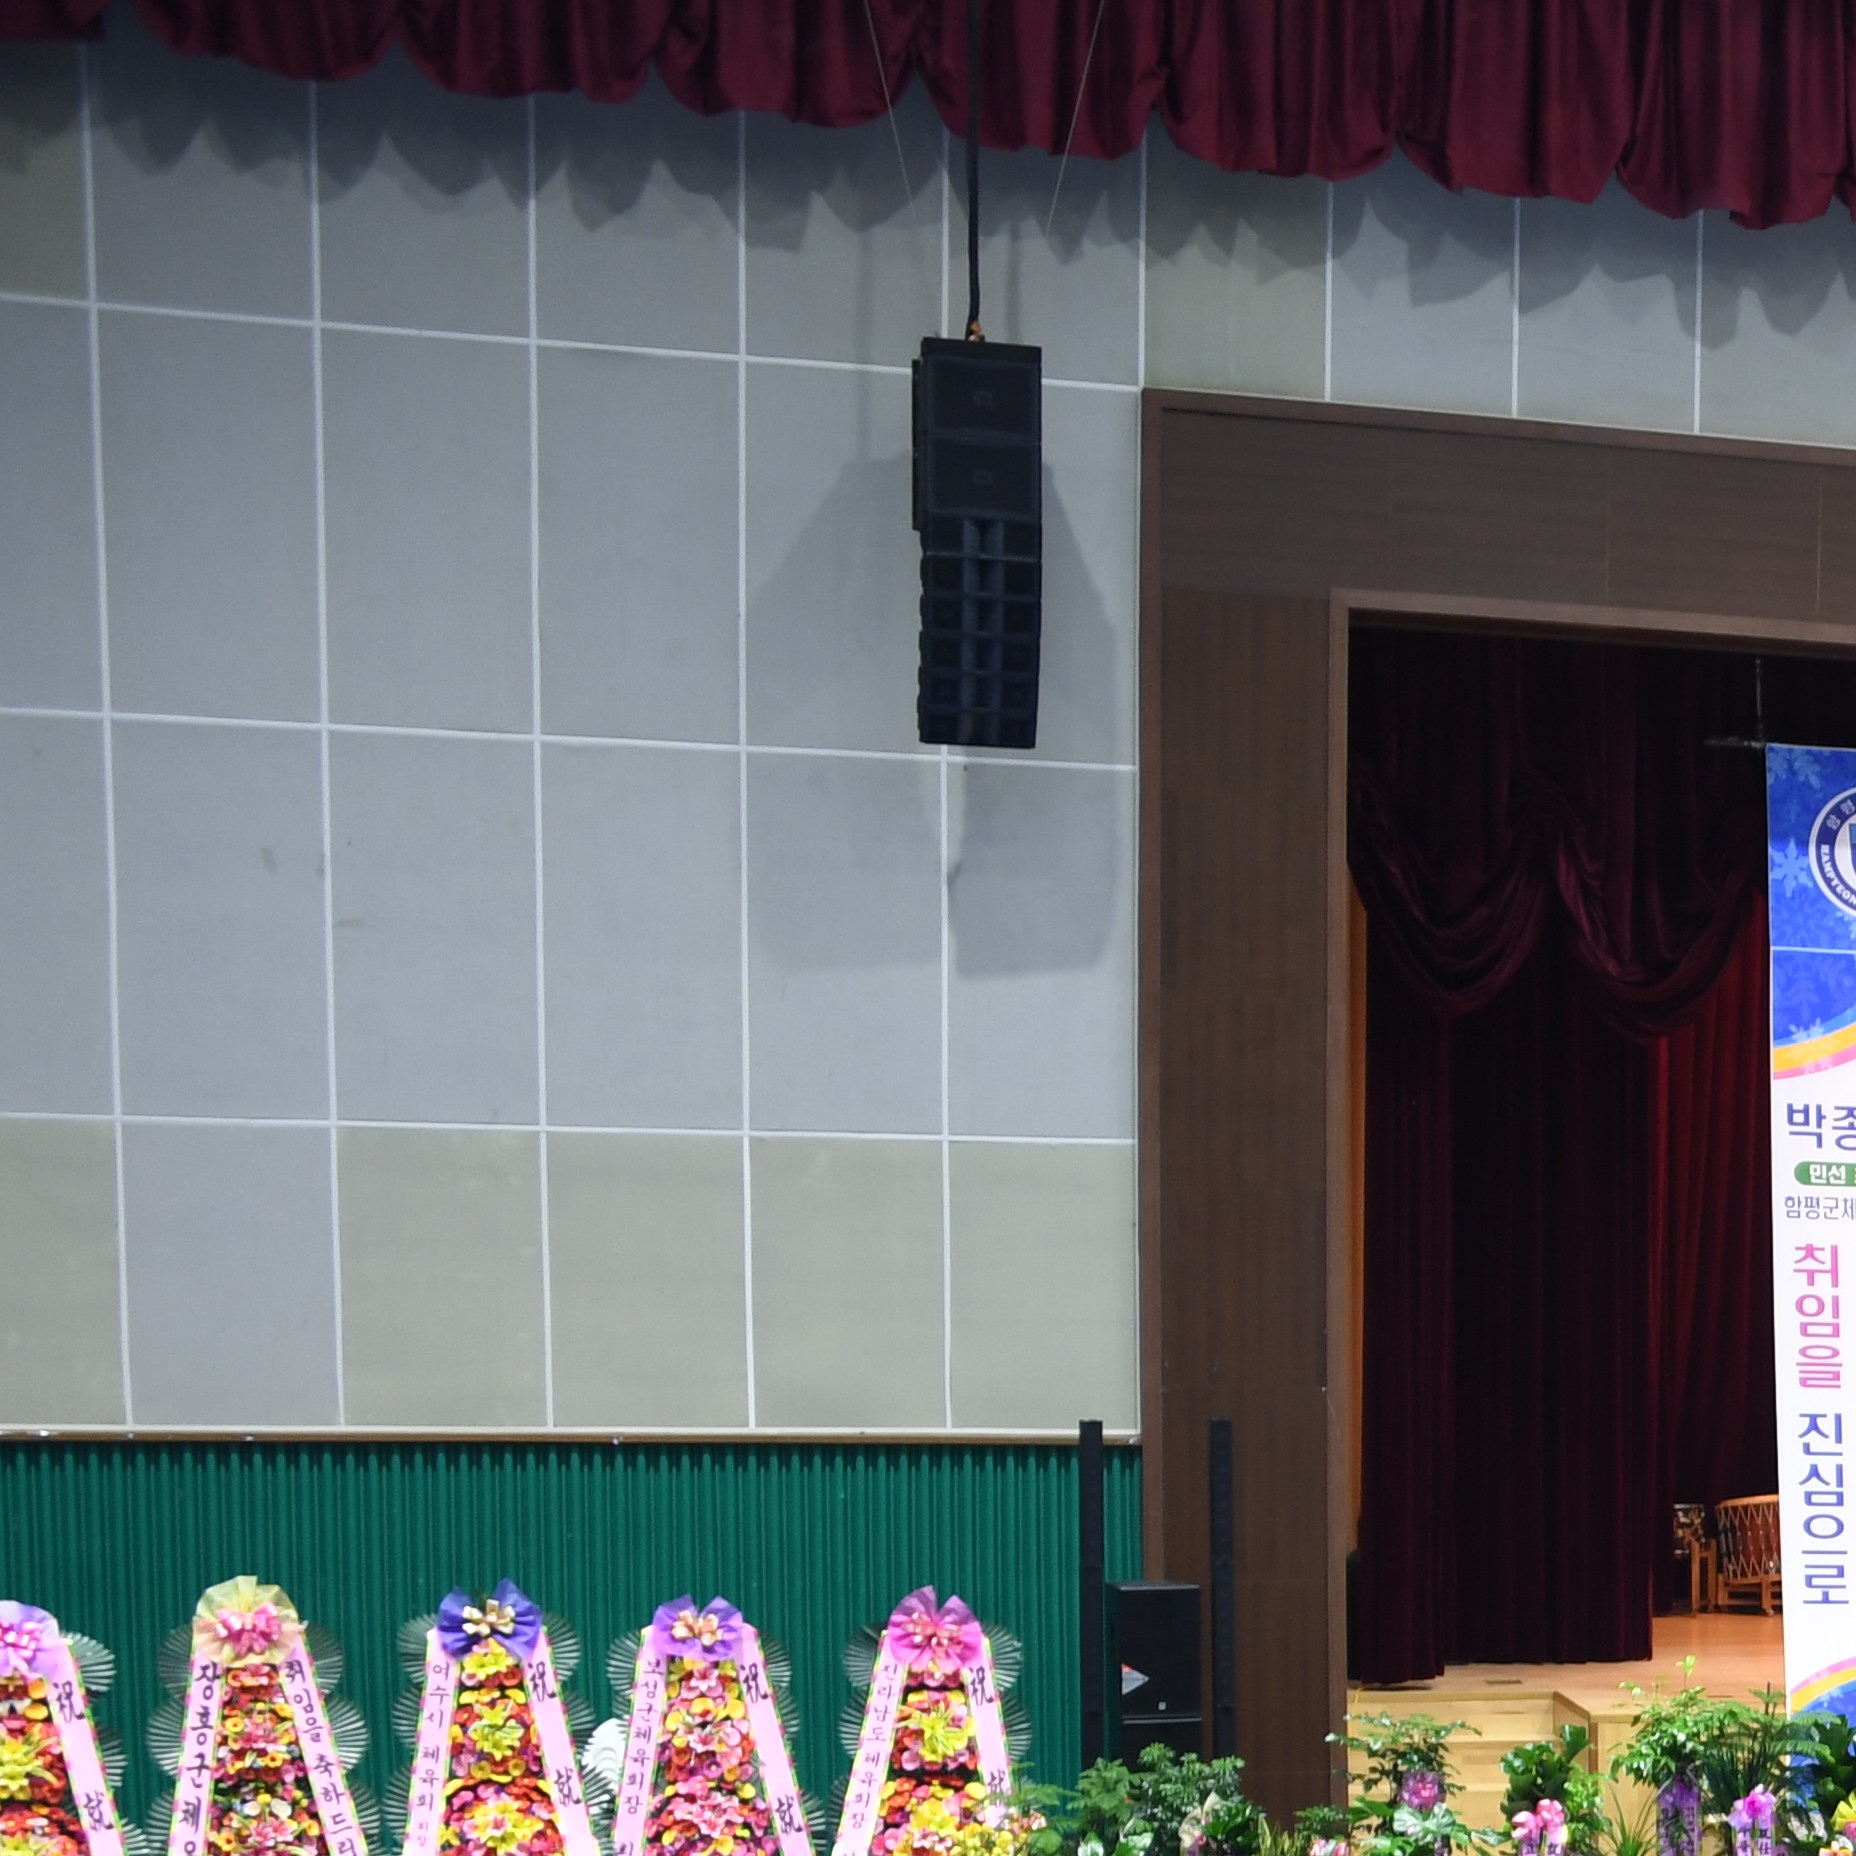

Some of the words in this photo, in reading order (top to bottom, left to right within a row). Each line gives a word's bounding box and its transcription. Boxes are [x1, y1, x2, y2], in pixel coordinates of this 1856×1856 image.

[1809, 1164, 1847, 1185] 민선
[1793, 1243, 1843, 1389] 취임을
[1797, 1413, 1850, 1605] 진심으로
[283, 1659, 324, 1744] 취임을
